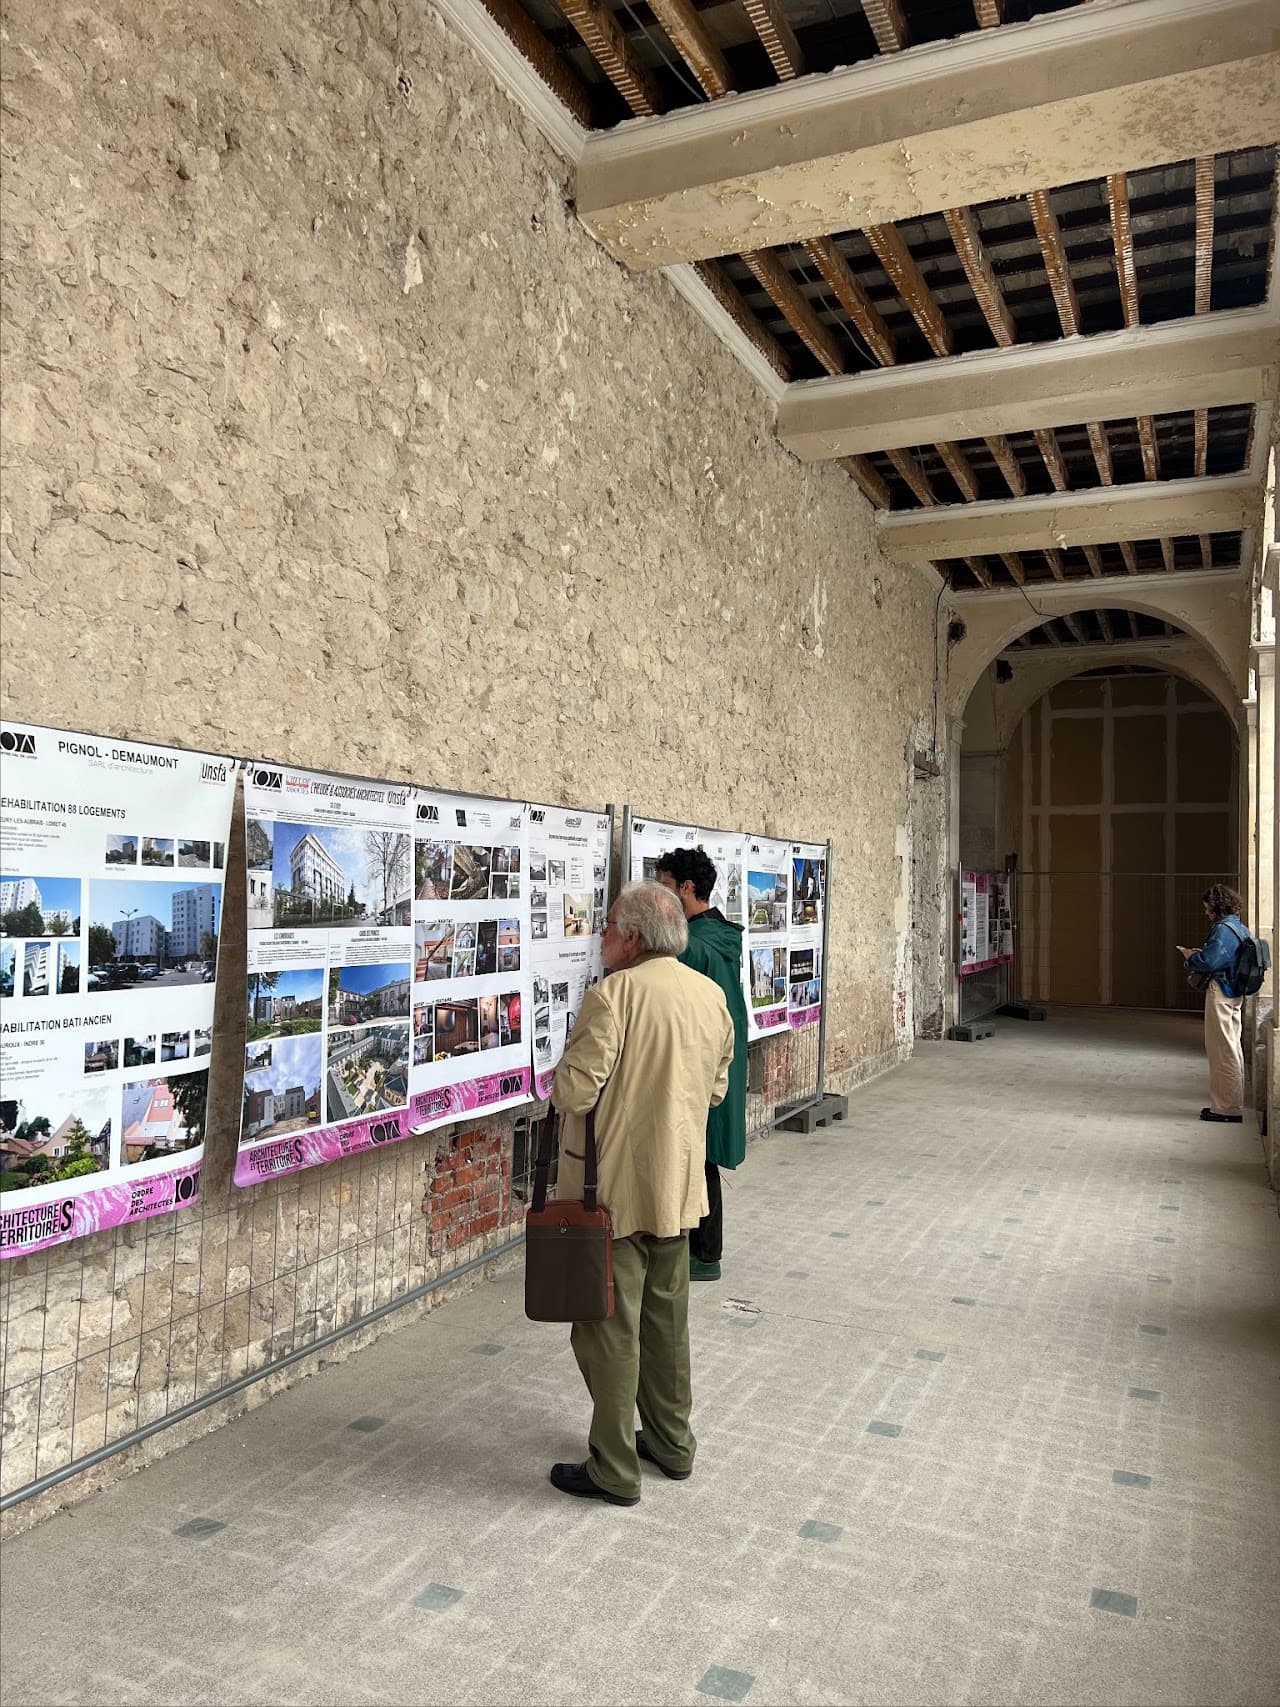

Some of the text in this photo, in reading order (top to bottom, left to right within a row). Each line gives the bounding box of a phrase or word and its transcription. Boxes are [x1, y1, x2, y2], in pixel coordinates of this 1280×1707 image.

[58, 741, 103, 758] PIGNOL
[112, 749, 179, 769] DEMAUMONT
[1, 797, 126, 819] EHABILITATION 88 LOGEMENTS
[63, 1017, 82, 1028] BATI
[83, 1014, 112, 1026] ANCIEN
[131, 1187, 154, 1199] ORDRE
[129, 1199, 174, 1216] ARCHITECTES
[131, 1199, 144, 1208] DES
